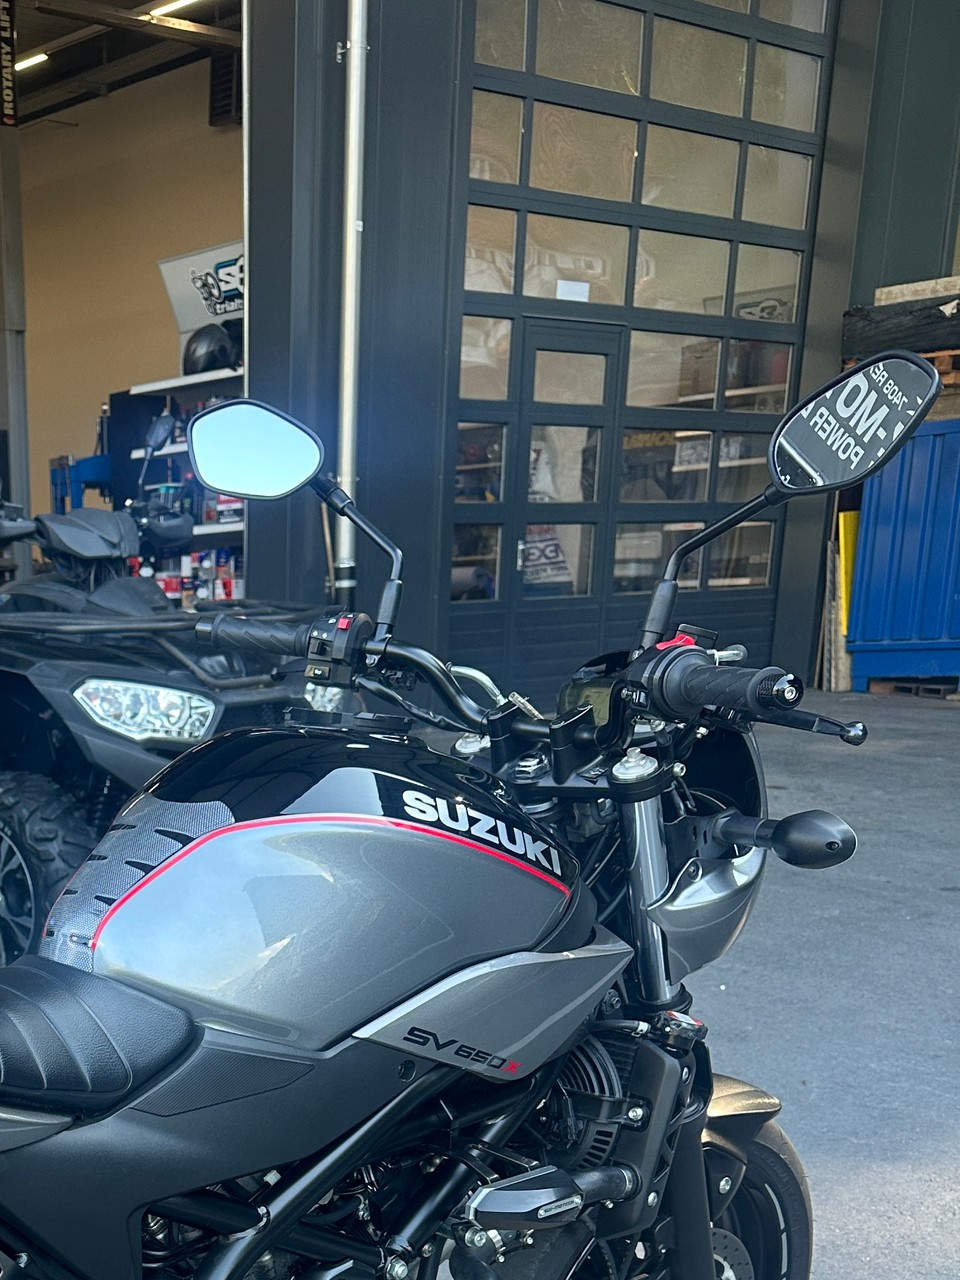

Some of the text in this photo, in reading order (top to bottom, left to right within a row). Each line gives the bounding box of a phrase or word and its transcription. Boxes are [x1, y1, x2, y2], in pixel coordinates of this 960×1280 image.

[0, 0, 15, 115] ROTARY LIFT
[402, 790, 562, 877] SUZUKI
